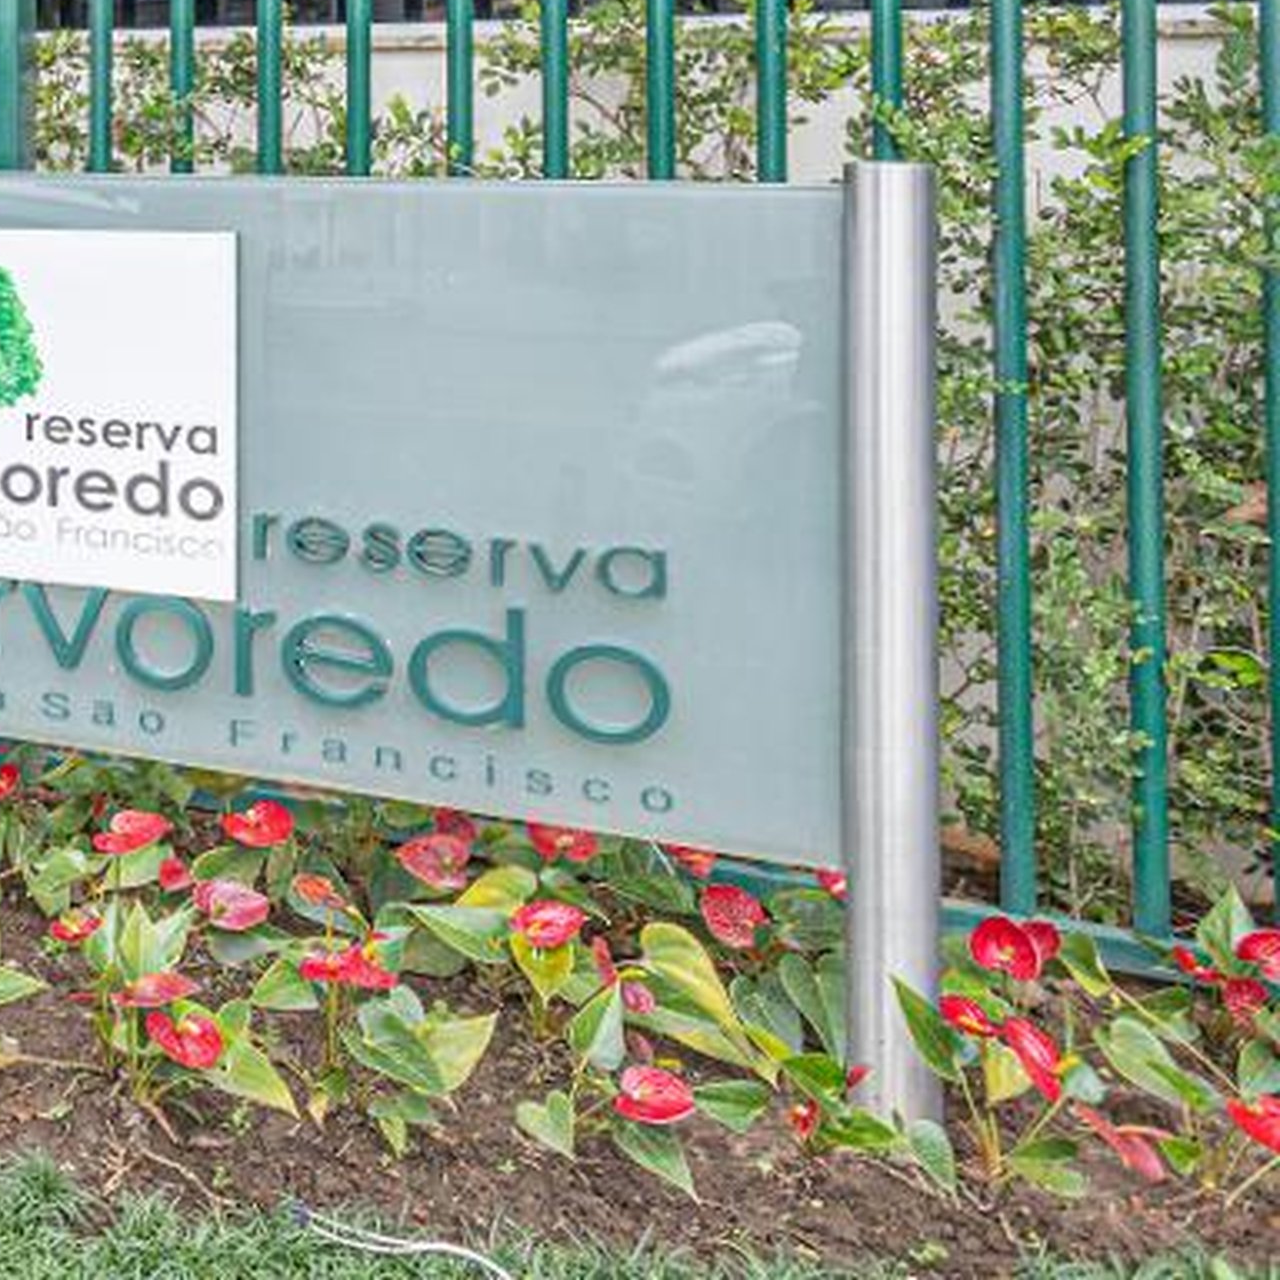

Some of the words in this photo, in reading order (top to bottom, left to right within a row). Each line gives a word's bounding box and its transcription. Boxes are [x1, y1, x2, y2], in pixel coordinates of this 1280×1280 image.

[25, 412, 218, 455] reserva
[56, 517, 224, 561] Francisco
[252, 513, 668, 600] reserva
[230, 718, 675, 815] Francisco
